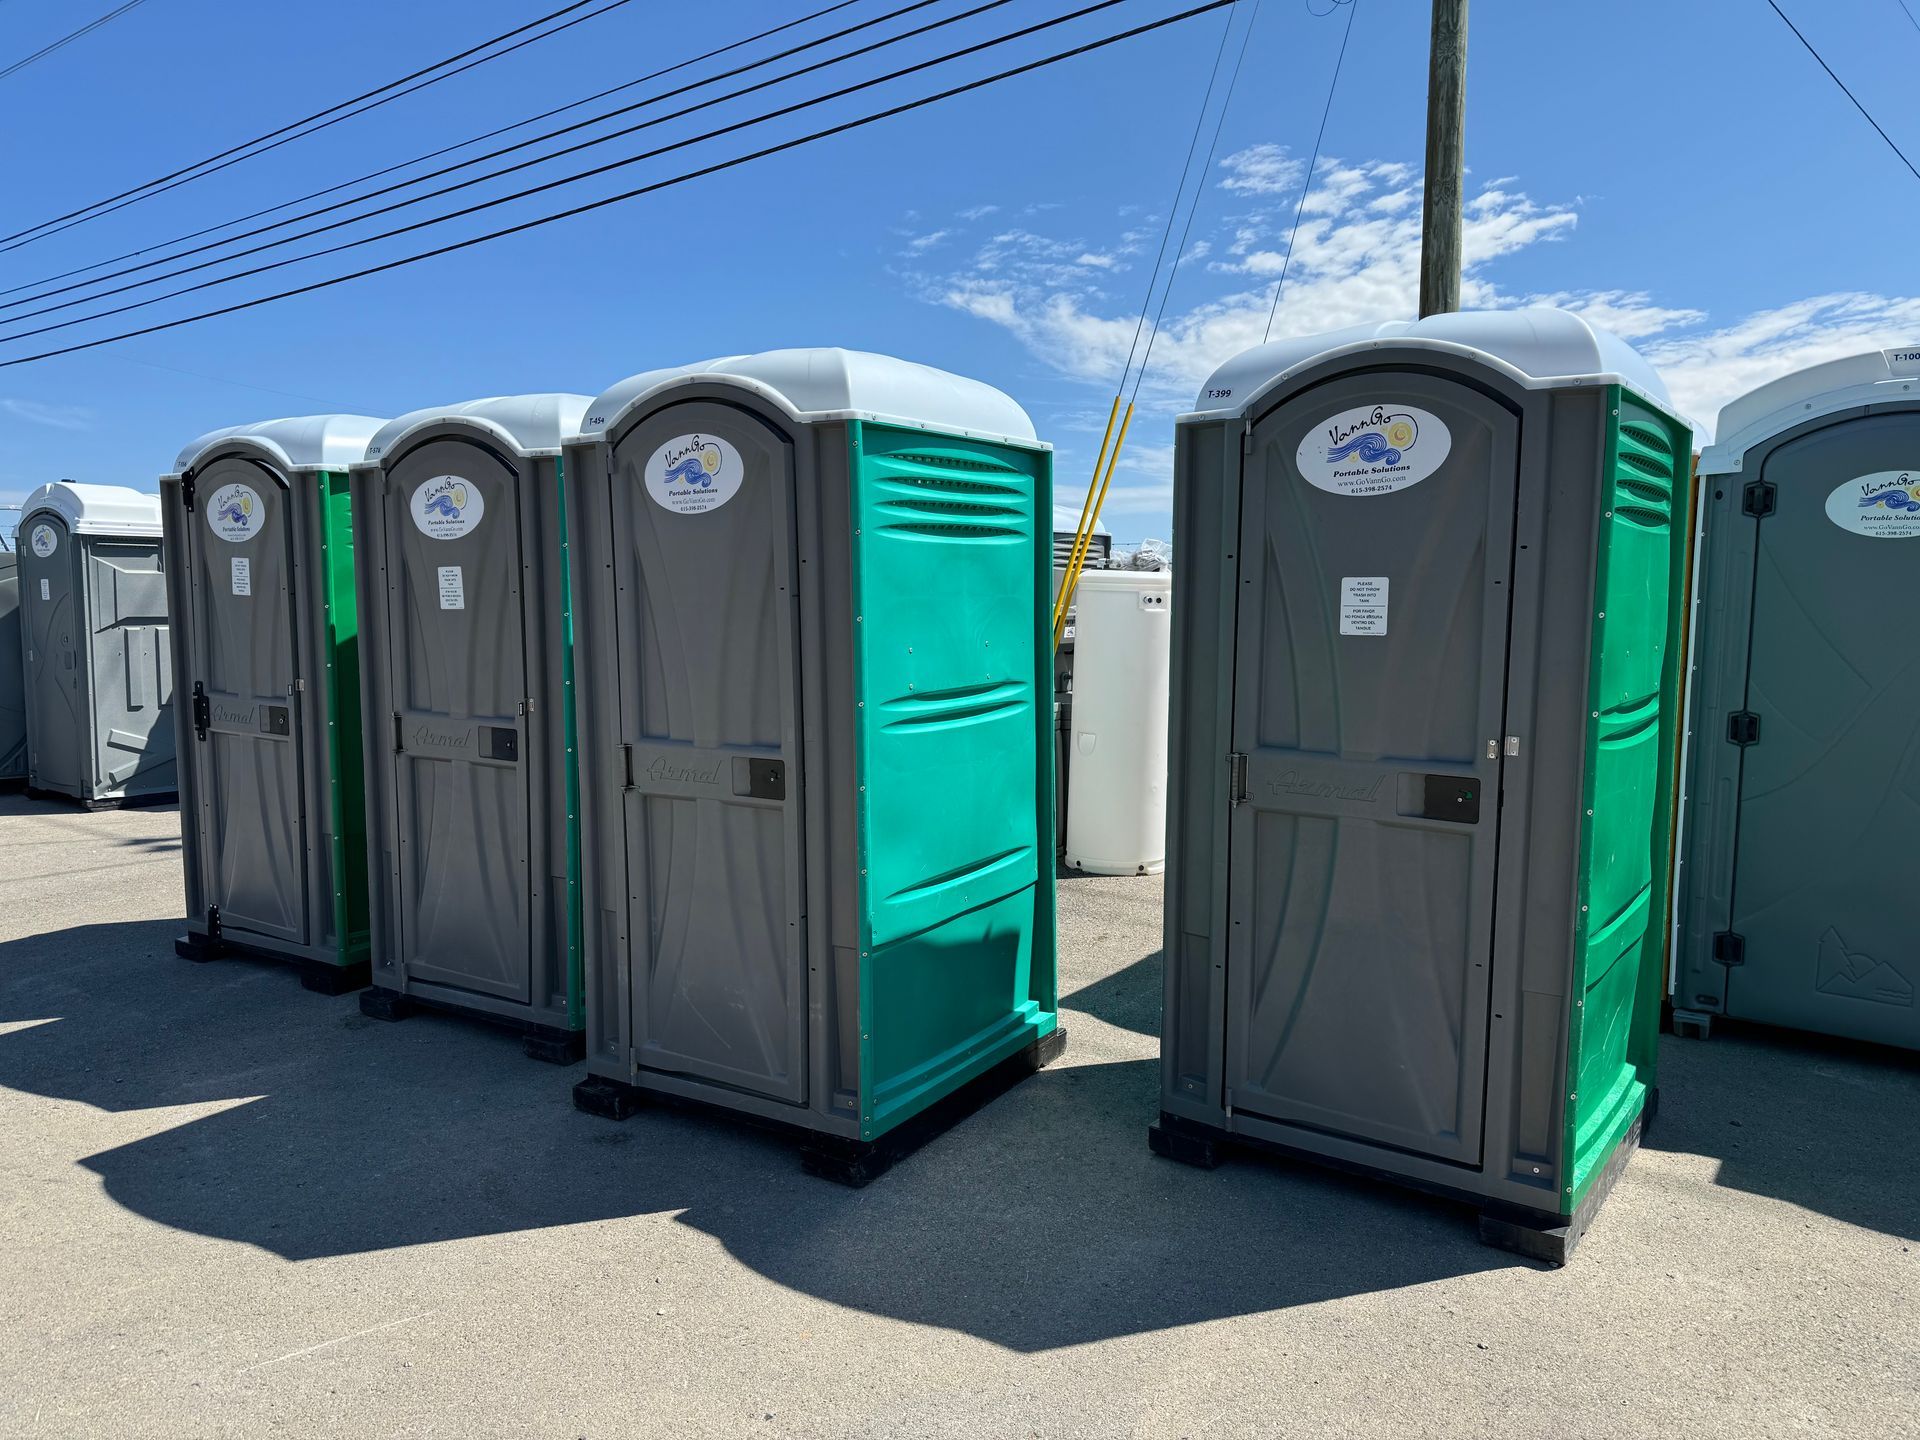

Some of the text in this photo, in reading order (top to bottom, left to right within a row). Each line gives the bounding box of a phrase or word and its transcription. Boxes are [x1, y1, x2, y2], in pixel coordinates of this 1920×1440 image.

[1208, 389, 1232, 399] T-399
[590, 417, 604, 426] T-454
[1328, 405, 1393, 446] VannGo
[664, 434, 706, 468] VannGo
[1333, 464, 1411, 478] Portable Solutions
[1337, 475, 1407, 487] www.GoVannGo.com
[424, 476, 456, 503] VannGo
[1350, 484, 1392, 494] 615-398-2574
[1861, 472, 1915, 497] VannGo
[646, 755, 722, 785] Armal
[1266, 768, 1388, 803] Armal
